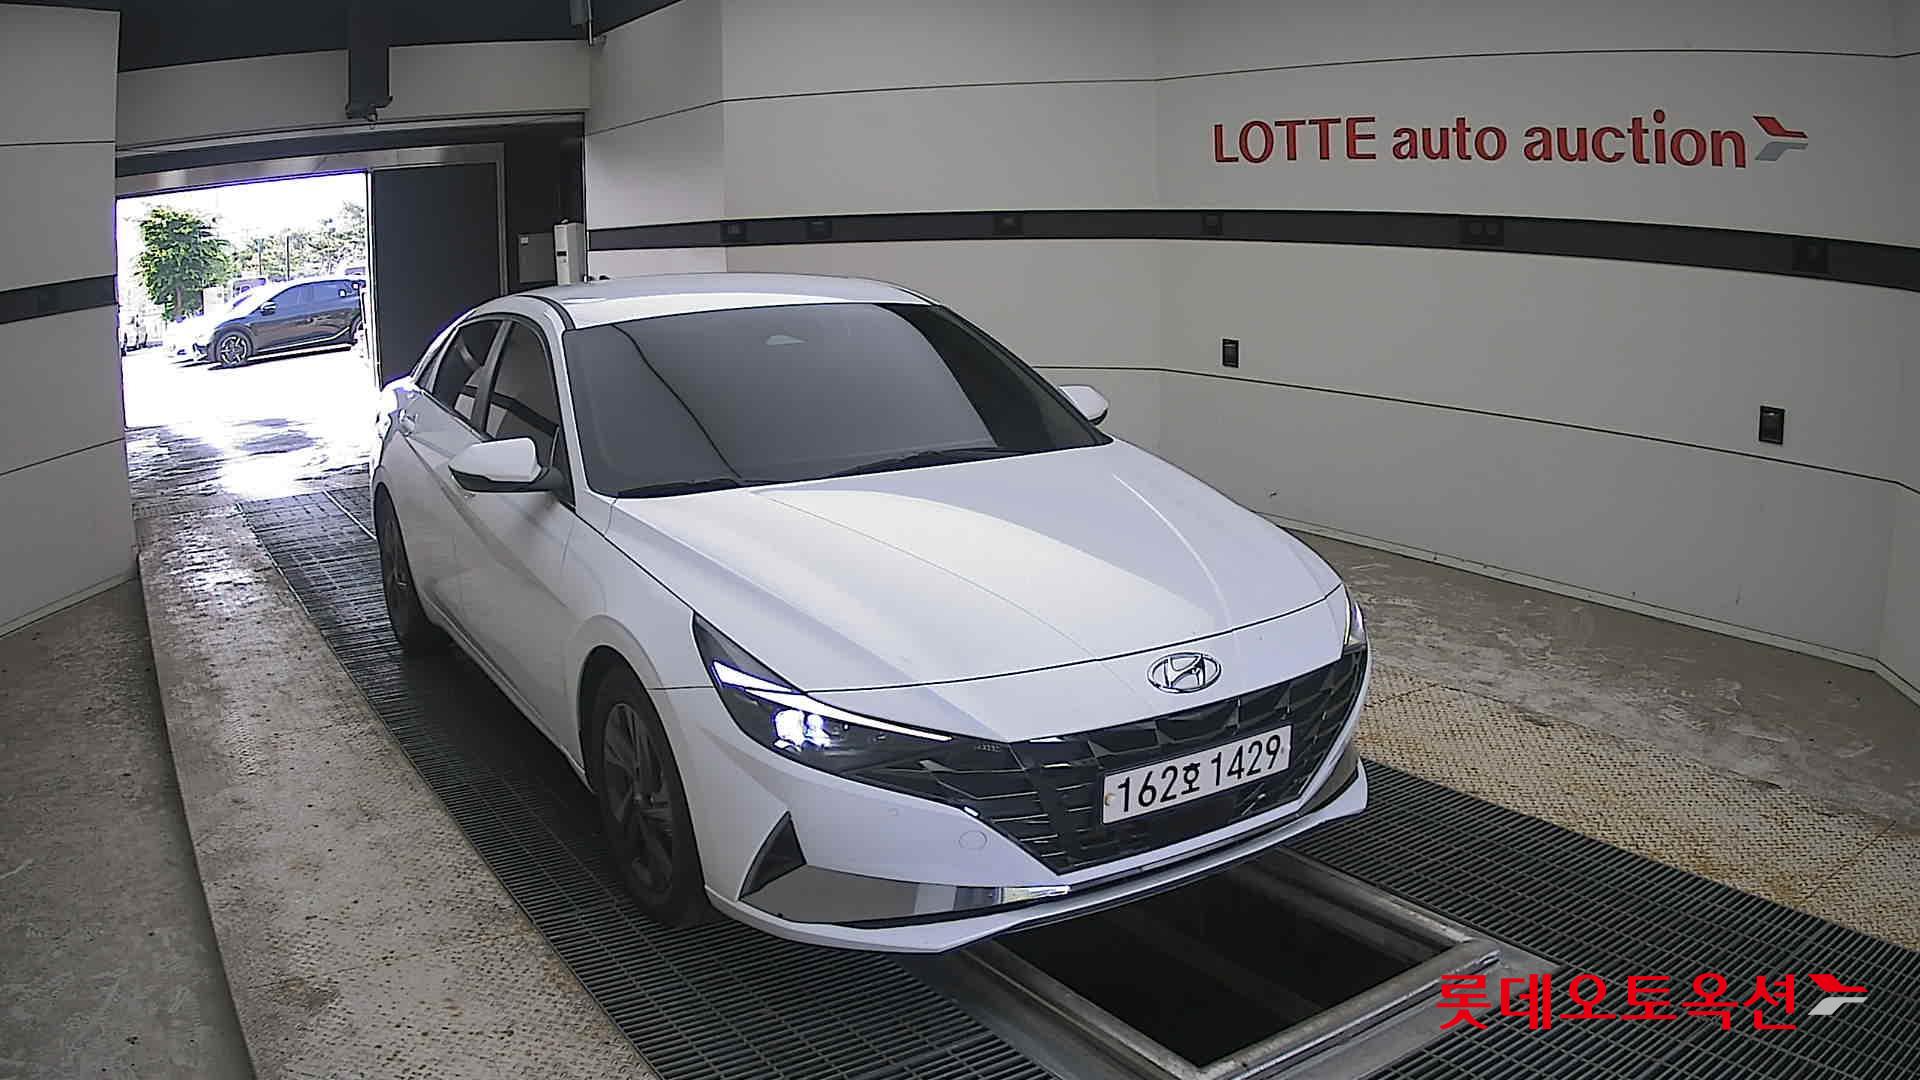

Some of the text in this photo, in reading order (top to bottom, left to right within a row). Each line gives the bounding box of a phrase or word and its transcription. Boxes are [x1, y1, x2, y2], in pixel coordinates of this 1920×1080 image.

[1213, 109, 1747, 168] LOTTE auto auction
[1211, 734, 1281, 787] 1429
